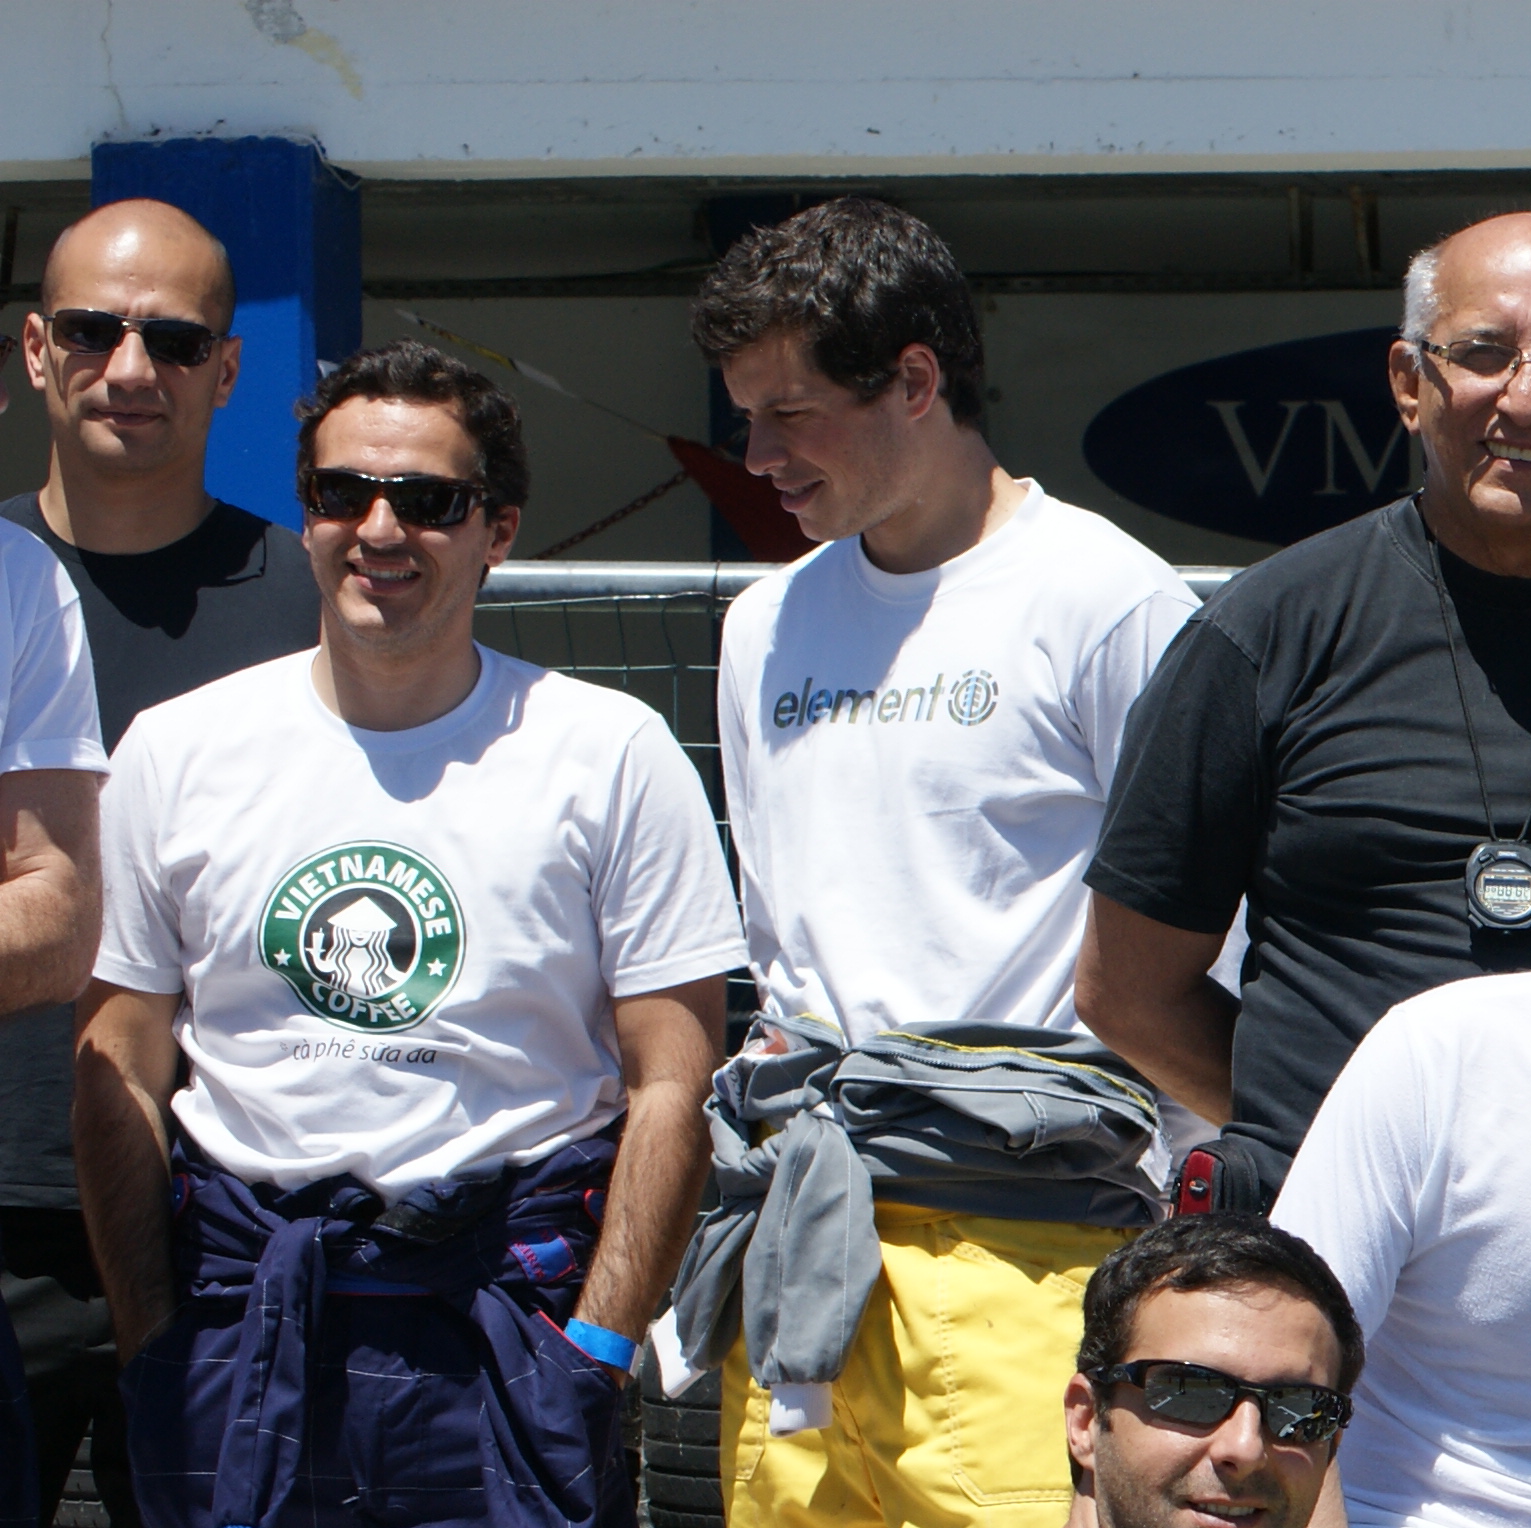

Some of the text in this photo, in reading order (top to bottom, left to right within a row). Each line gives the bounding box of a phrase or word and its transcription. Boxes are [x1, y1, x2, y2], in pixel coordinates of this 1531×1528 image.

[773, 673, 945, 729] element
[275, 854, 452, 938] VIETNAMESE
[312, 982, 417, 1023] COFFEE
